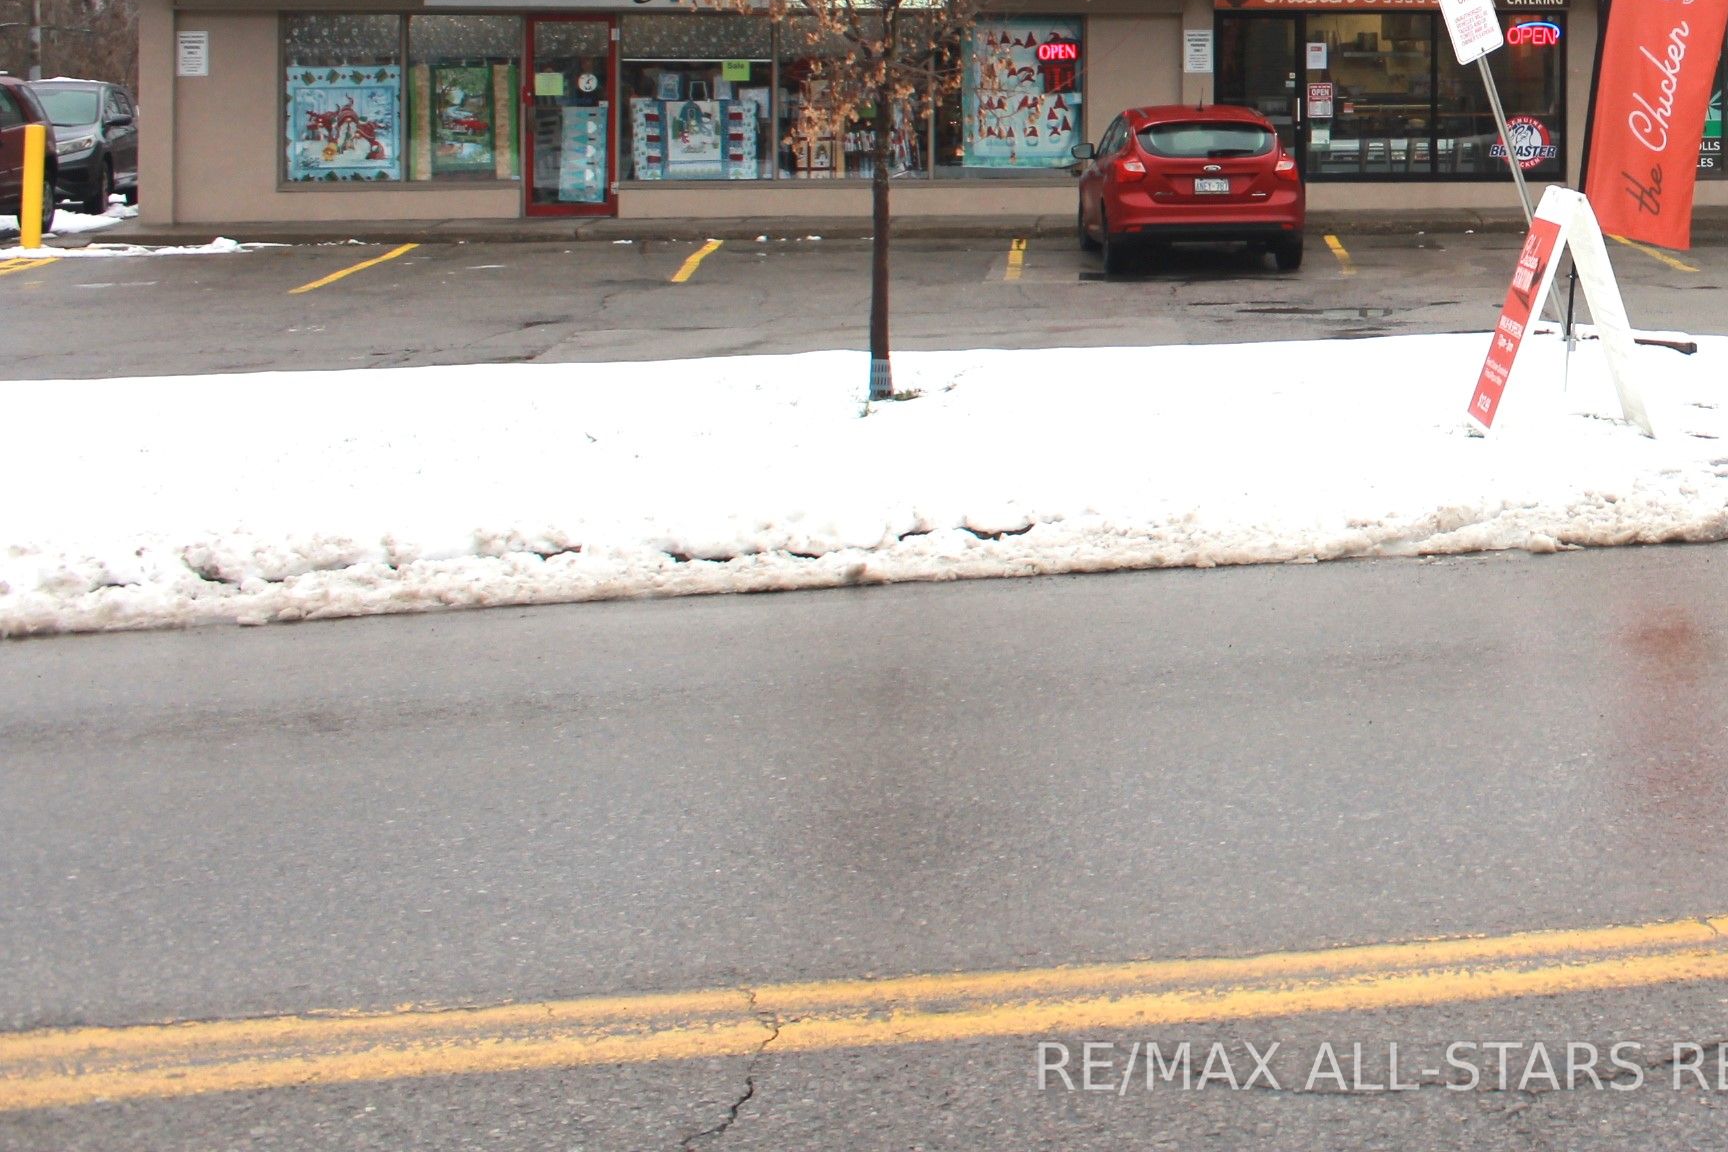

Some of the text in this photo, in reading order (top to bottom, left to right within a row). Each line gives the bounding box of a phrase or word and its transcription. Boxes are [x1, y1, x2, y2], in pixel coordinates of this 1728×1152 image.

[1507, 28, 1556, 44] OPEN
[1038, 44, 1076, 60] OPEN
[727, 62, 745, 70] Sale
[1311, 88, 1329, 96] OPEN
[1628, 20, 1690, 152] Chicken
[1621, 163, 1663, 216] the
